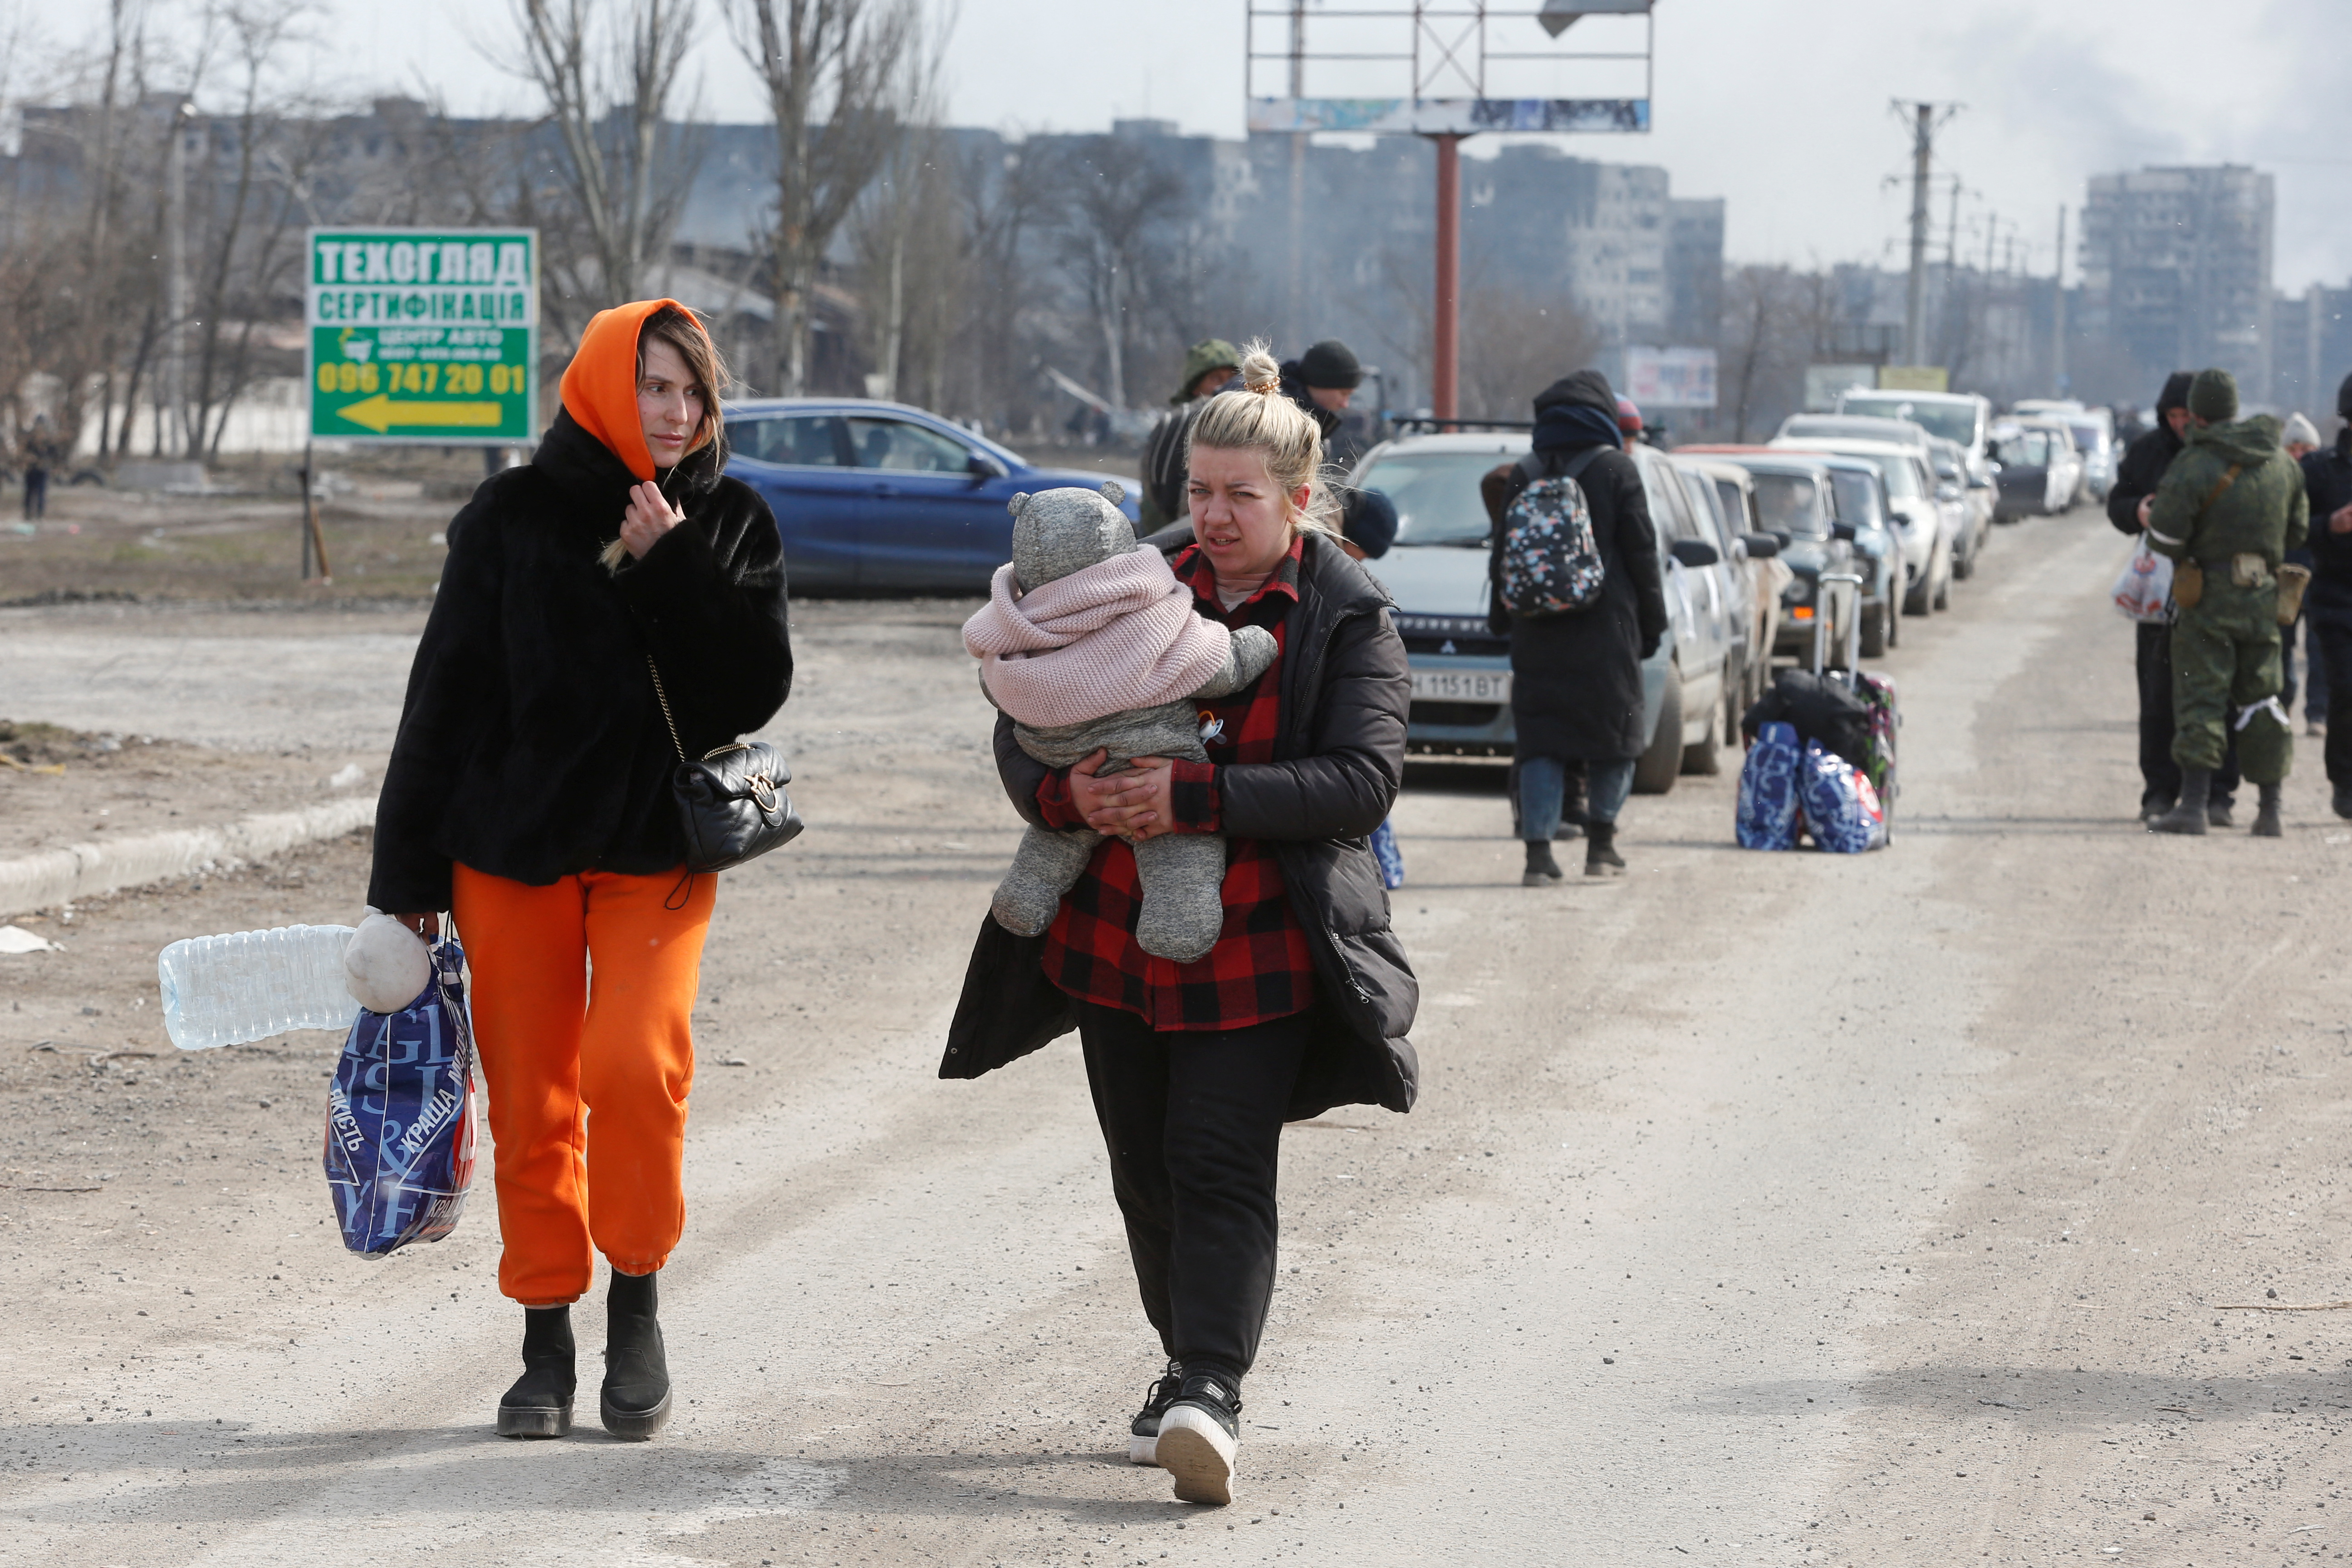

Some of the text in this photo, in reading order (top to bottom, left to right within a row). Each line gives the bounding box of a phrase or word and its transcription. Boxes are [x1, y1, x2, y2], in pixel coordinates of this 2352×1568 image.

[318, 241, 526, 288] ТЕХОГЛЯД
[319, 292, 524, 323] СЕРТИФІКАЦІЯ
[318, 362, 525, 395] 096 747 20 01
[330, 1088, 365, 1152] ЯКІСТЬ
[401, 1088, 457, 1154] КРАЩА
